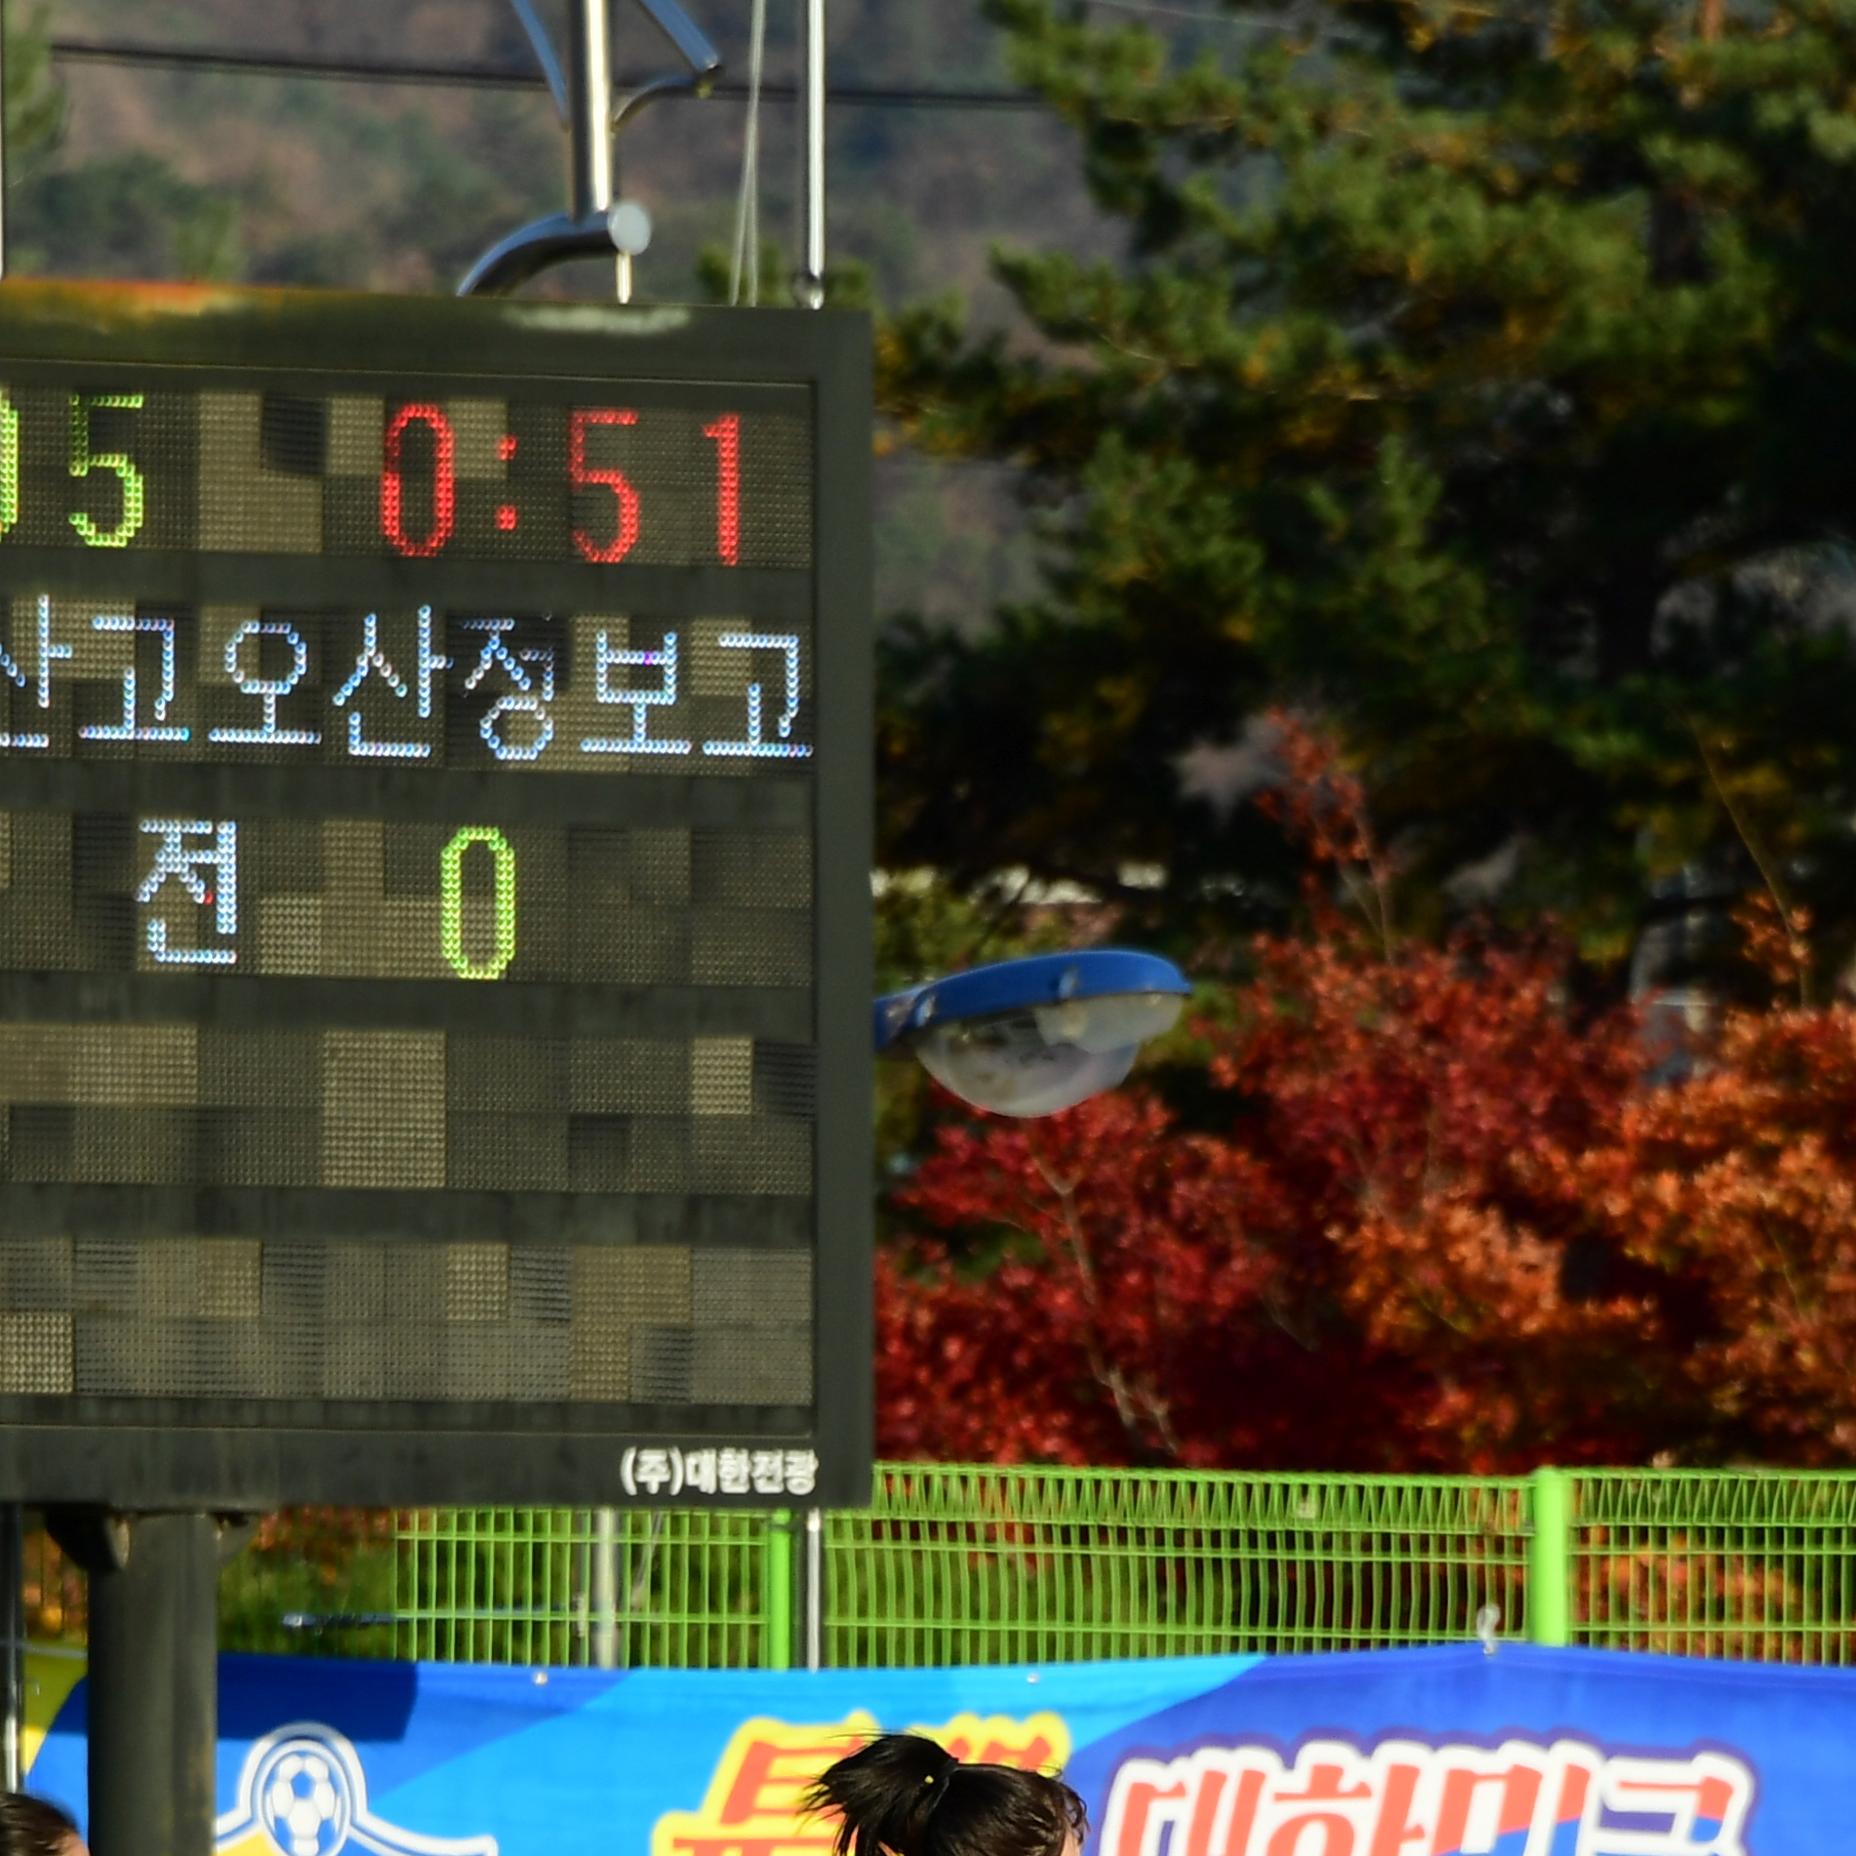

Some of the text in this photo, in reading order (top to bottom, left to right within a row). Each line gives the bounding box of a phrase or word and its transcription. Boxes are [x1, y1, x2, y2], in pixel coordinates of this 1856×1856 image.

[379, 403, 741, 566] 0:51
[136, 819, 237, 963] 전
[440, 825, 516, 980] 0
